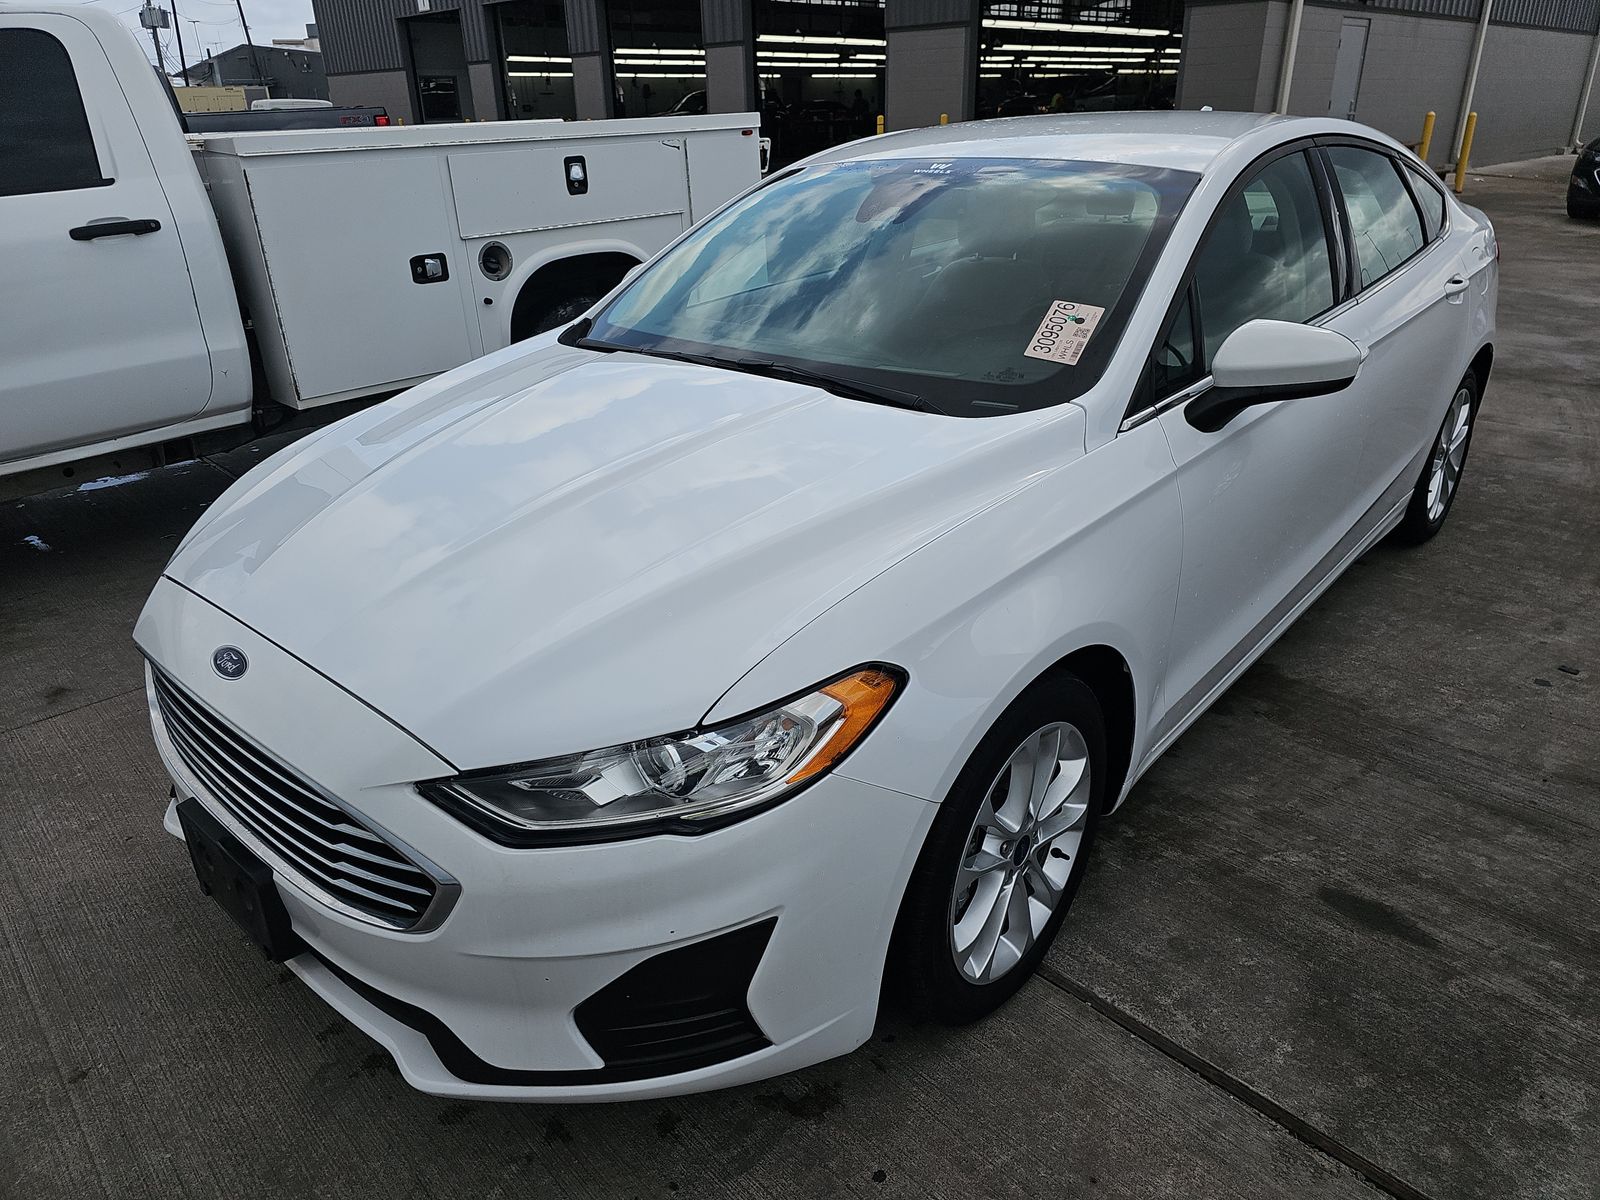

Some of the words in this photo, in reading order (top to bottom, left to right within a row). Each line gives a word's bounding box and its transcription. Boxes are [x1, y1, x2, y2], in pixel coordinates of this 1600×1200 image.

[1033, 302, 1075, 353] 3095076
[1058, 340, 1074, 359] WHLS
[217, 651, 240, 672] Ford
